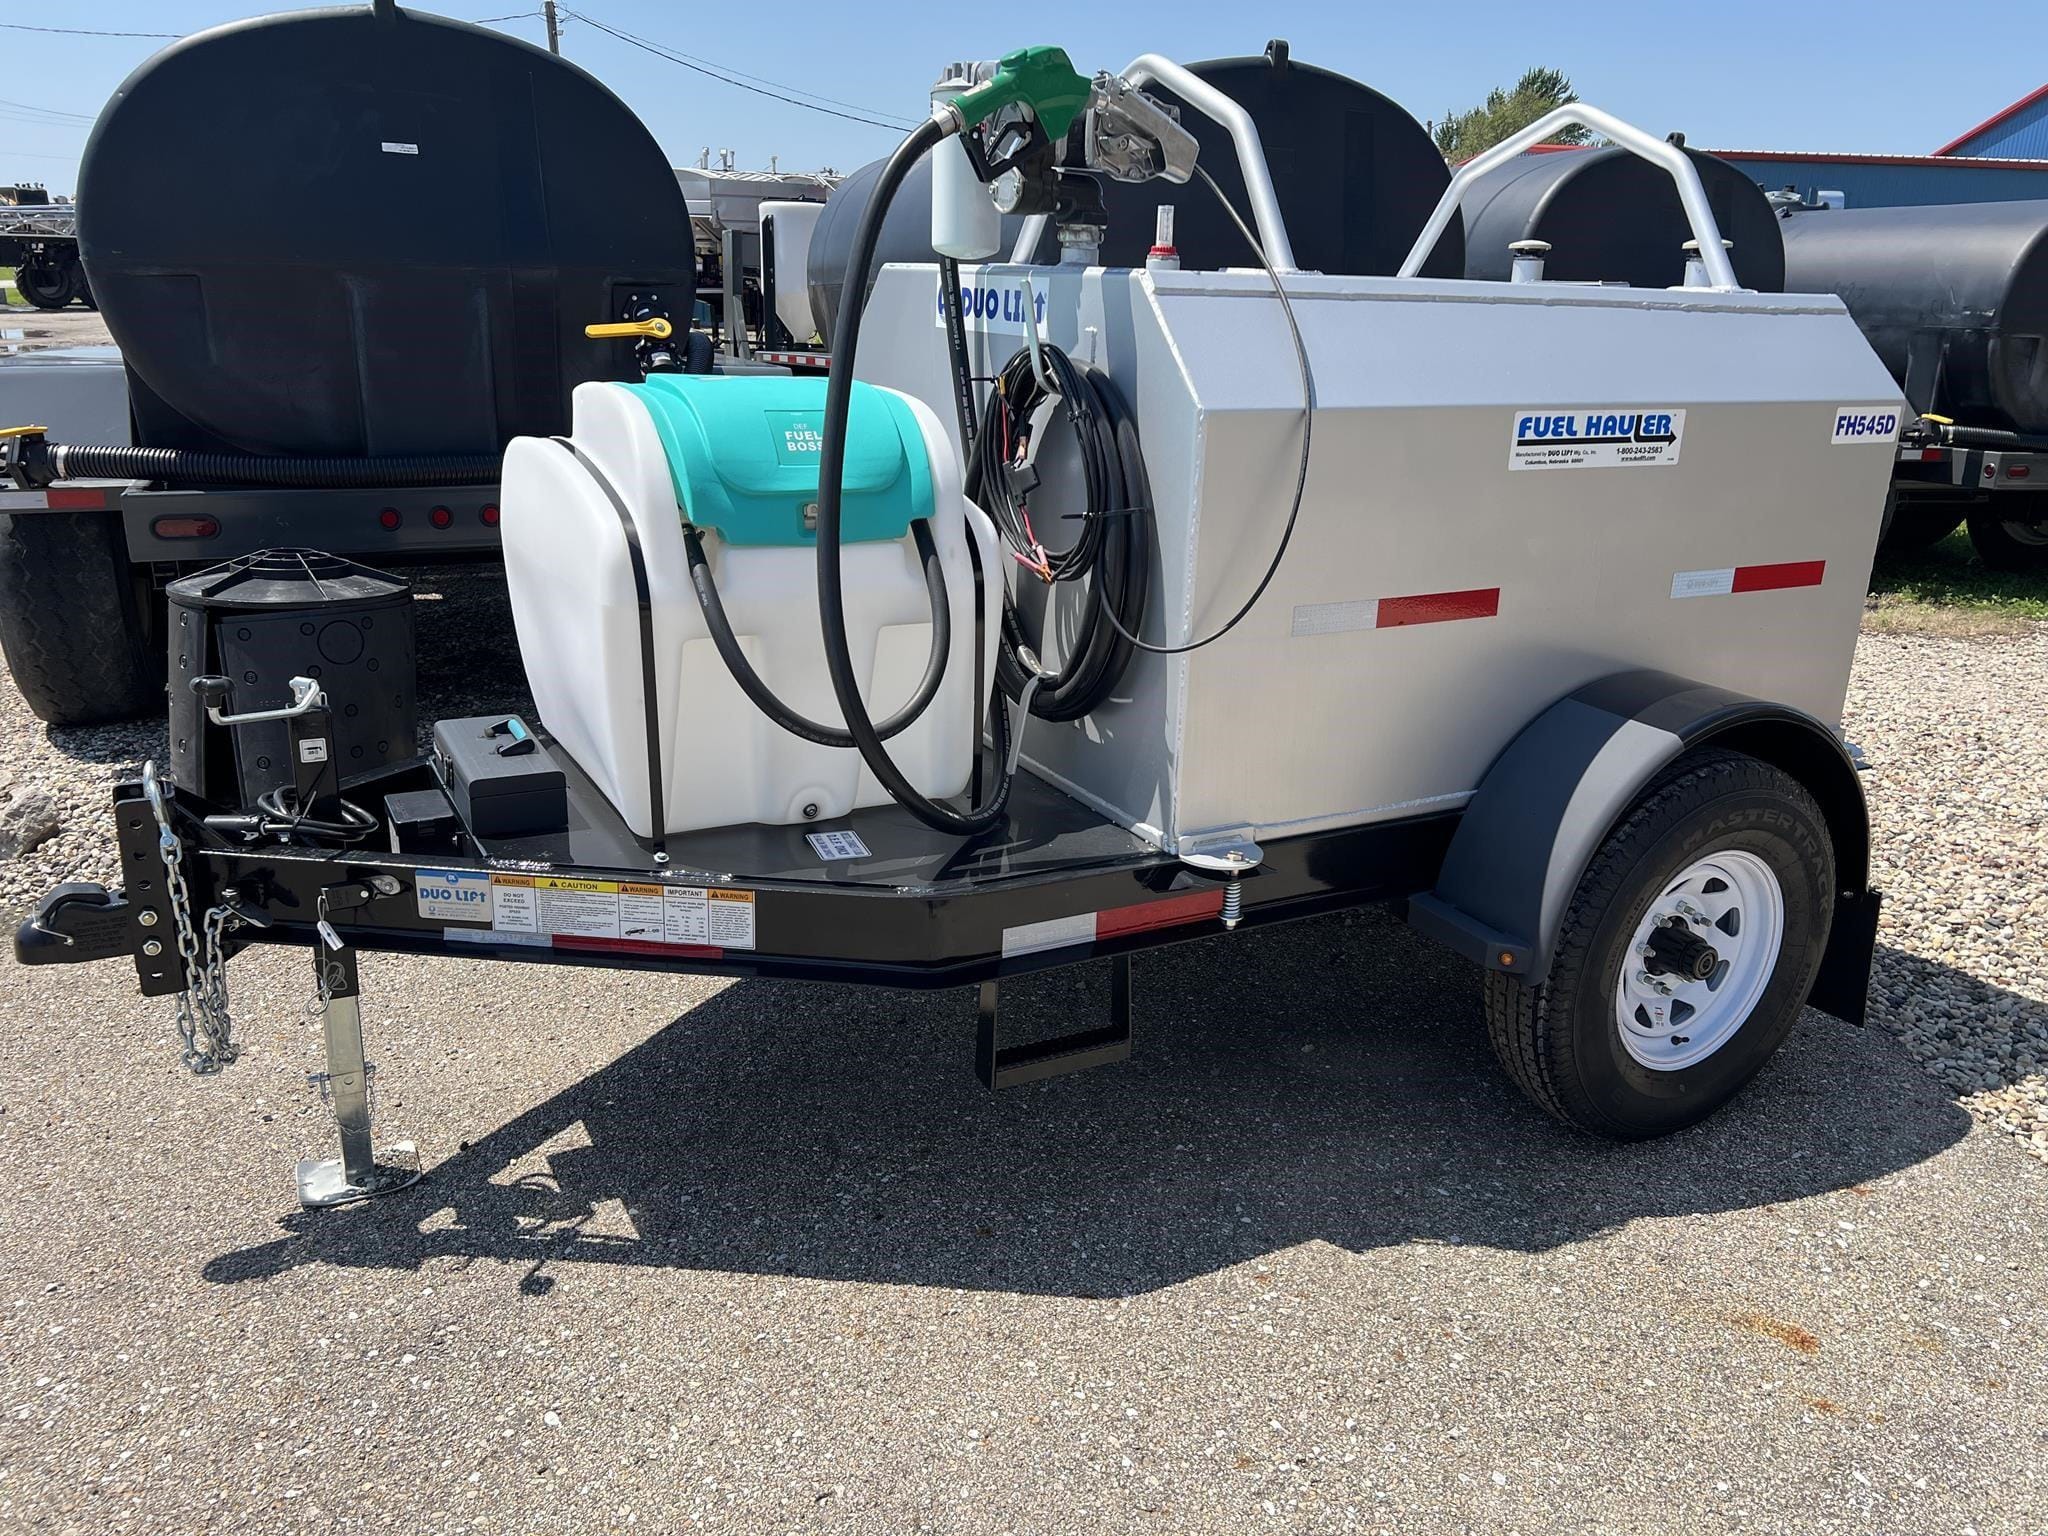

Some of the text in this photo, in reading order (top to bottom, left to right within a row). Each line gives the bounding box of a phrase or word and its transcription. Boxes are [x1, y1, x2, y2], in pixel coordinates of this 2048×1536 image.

[1518, 414, 1673, 441] FUEL HAULER
[1835, 414, 1896, 436] FH545D
[784, 431, 822, 440] FUEL
[1548, 449, 1560, 457] DUO
[1616, 446, 1663, 455] 1-800-243-2583
[561, 882, 598, 890] CAUTION
[629, 886, 659, 894] WARNING
[419, 887, 451, 900] DUO
[667, 888, 703, 897] IMPORTANT
[720, 892, 749, 900] WARNING
